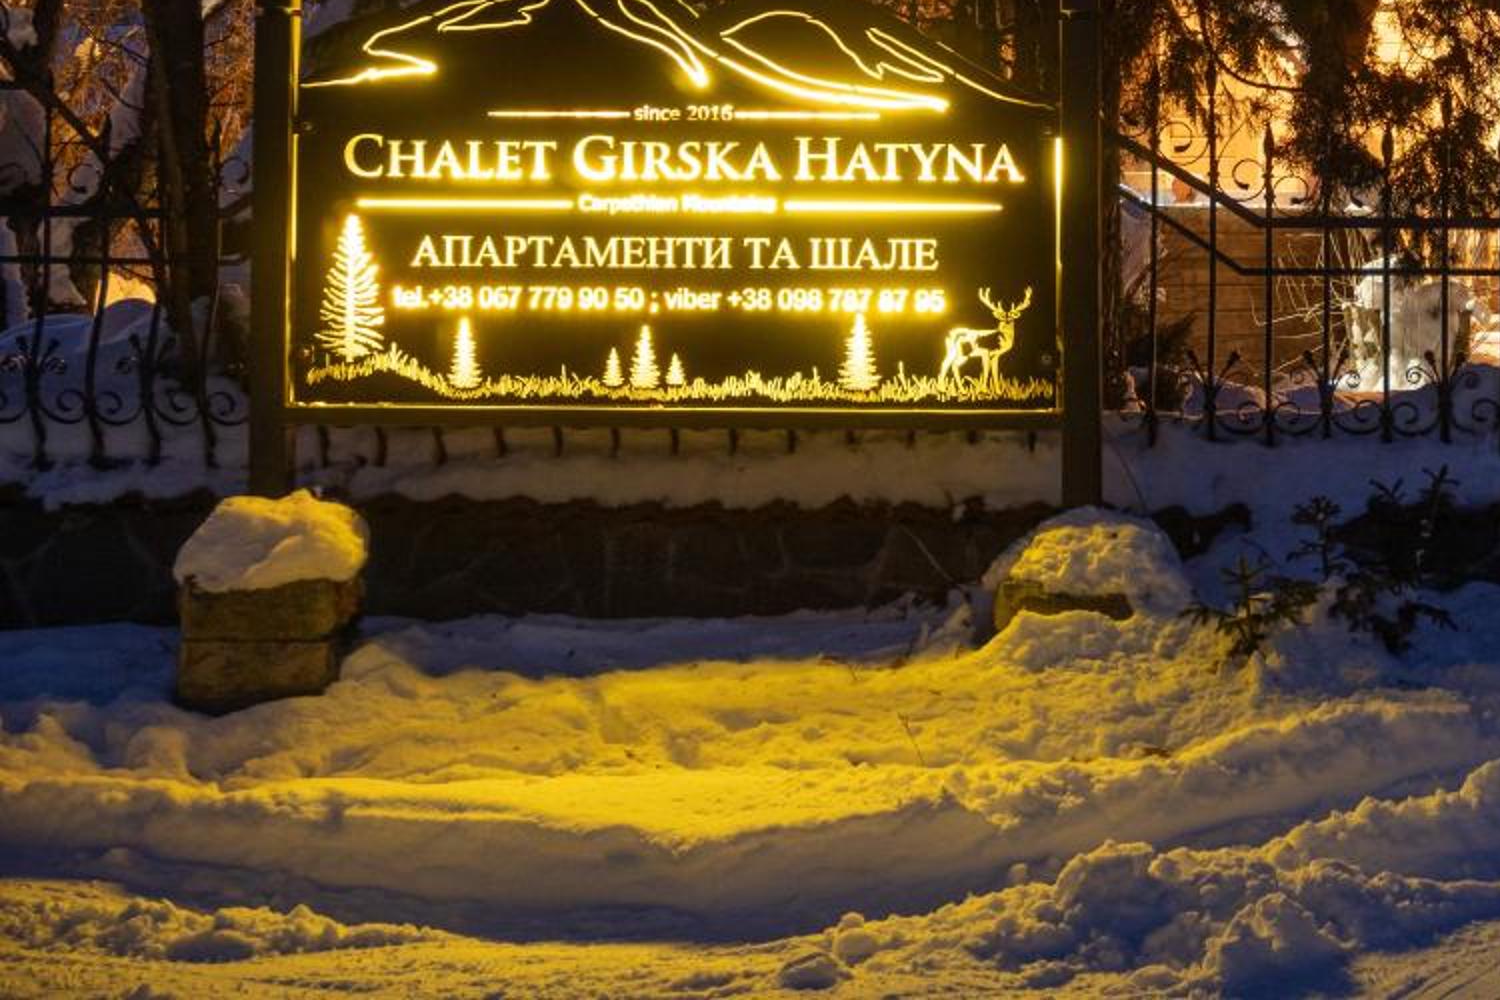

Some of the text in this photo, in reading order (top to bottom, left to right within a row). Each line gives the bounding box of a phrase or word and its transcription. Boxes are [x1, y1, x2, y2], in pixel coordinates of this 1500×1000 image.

[633, 104, 733, 121] since 2016
[343, 133, 1025, 183] CHALET GIRSKA HATYNA
[411, 235, 939, 271] АПАРТАМЕНТИ ТА ШАЛЕ
[478, 287, 521, 310] 067
[529, 287, 573, 310] 779
[577, 287, 609, 310] 90
[614, 288, 645, 310] 50
[664, 288, 721, 311] viber
[727, 288, 772, 311] +38
